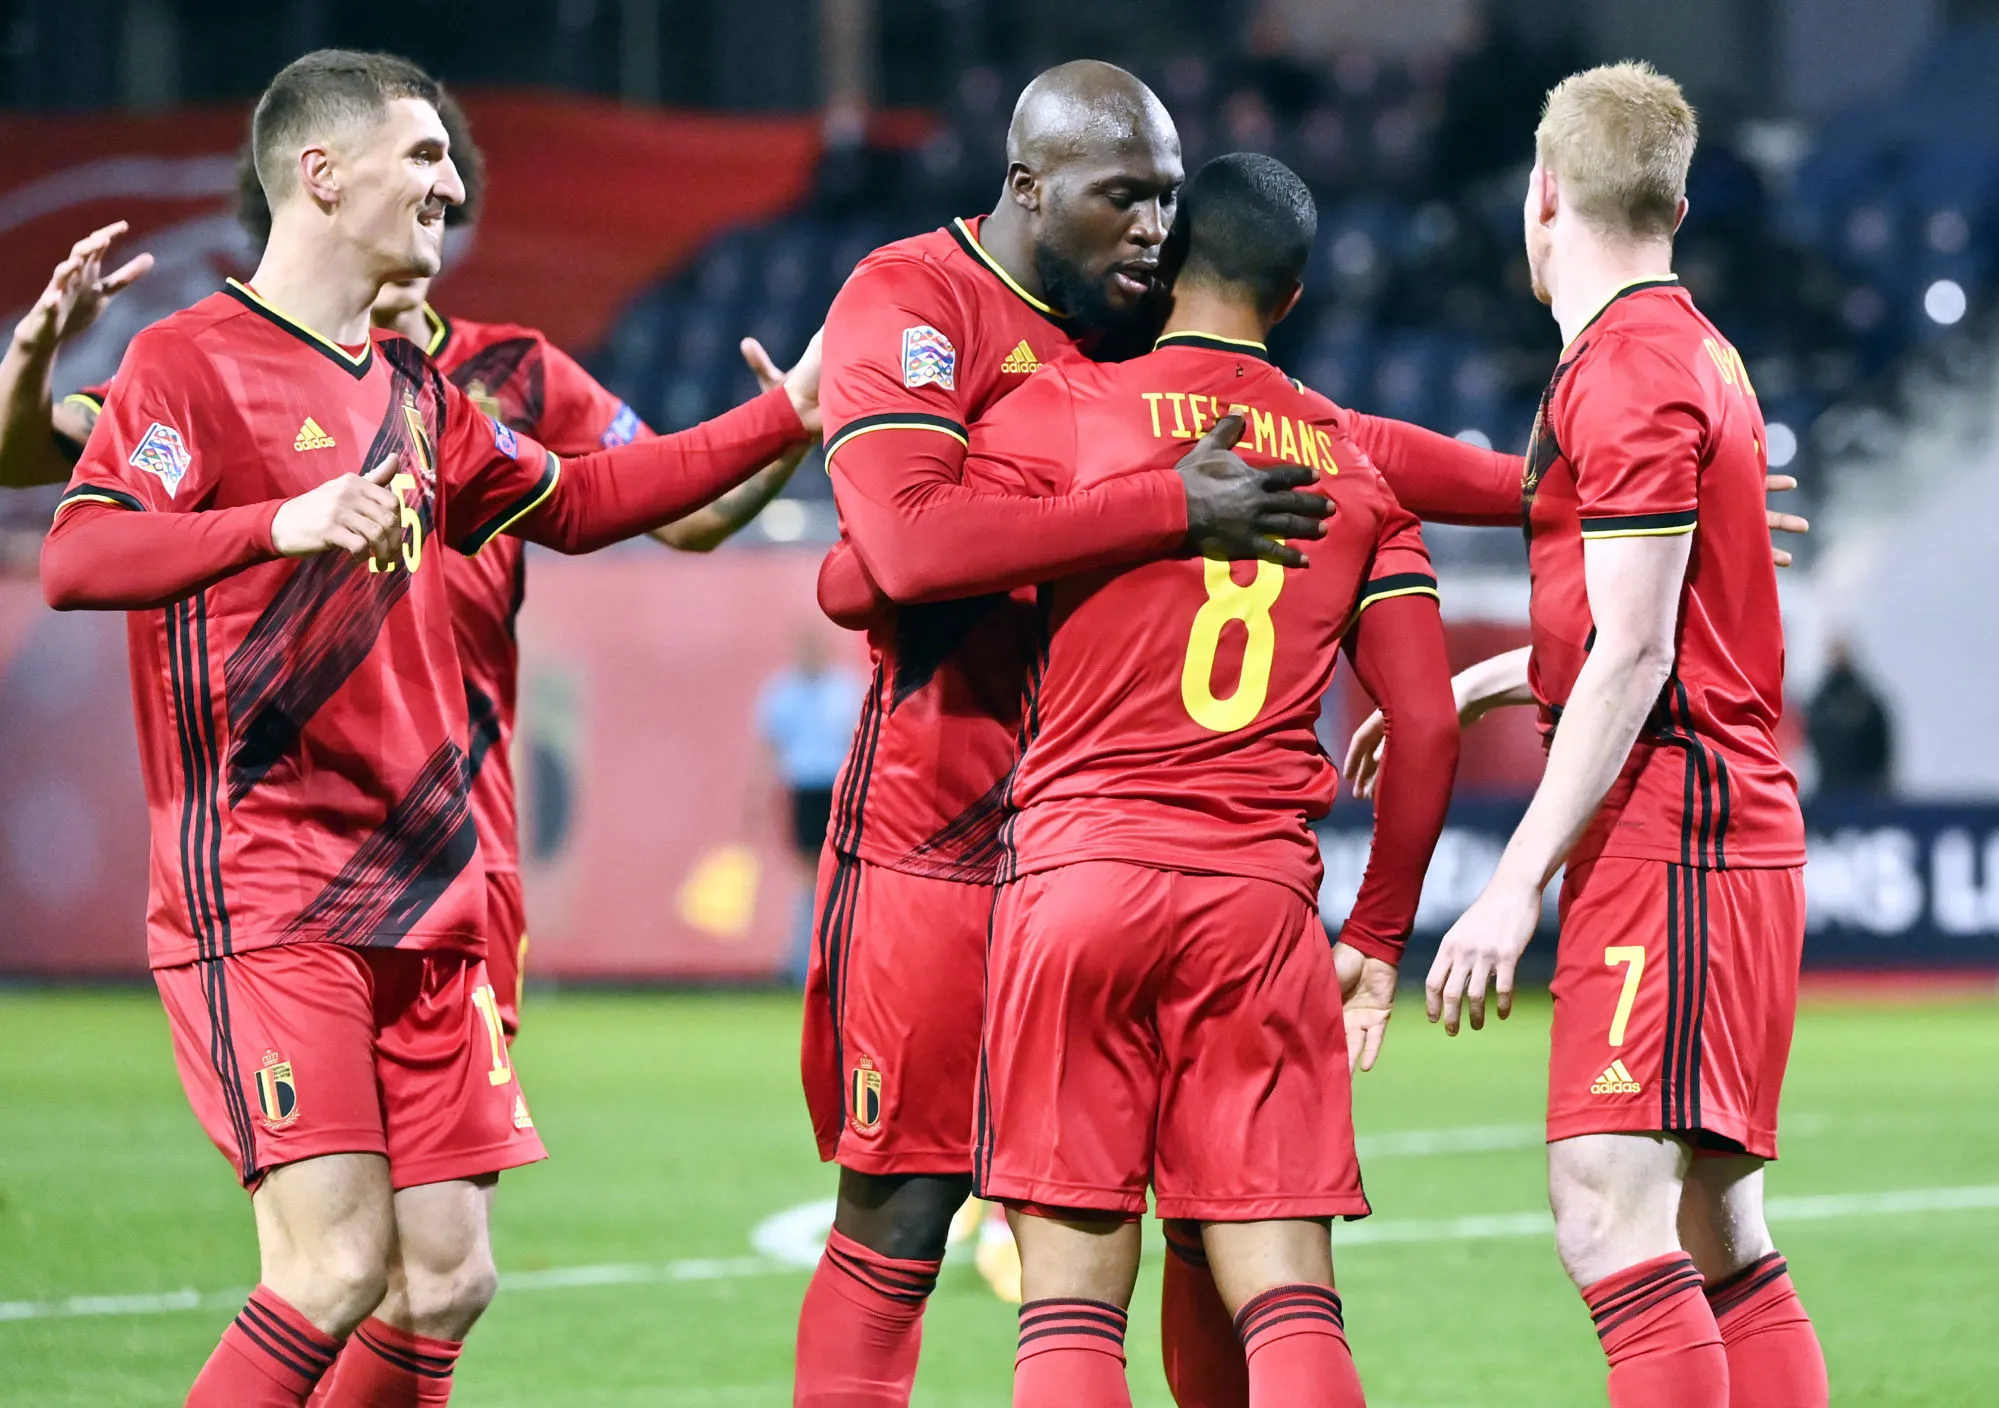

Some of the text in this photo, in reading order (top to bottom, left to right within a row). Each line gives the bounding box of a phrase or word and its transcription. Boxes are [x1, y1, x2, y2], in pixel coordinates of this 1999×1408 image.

[294, 436, 336, 452] adidas
[369, 473, 422, 573] 5
[1181, 537, 1285, 733] 8
[471, 983, 512, 1087] 1
[1604, 945, 1646, 1047] 7
[1590, 1081, 1641, 1095] adidas
